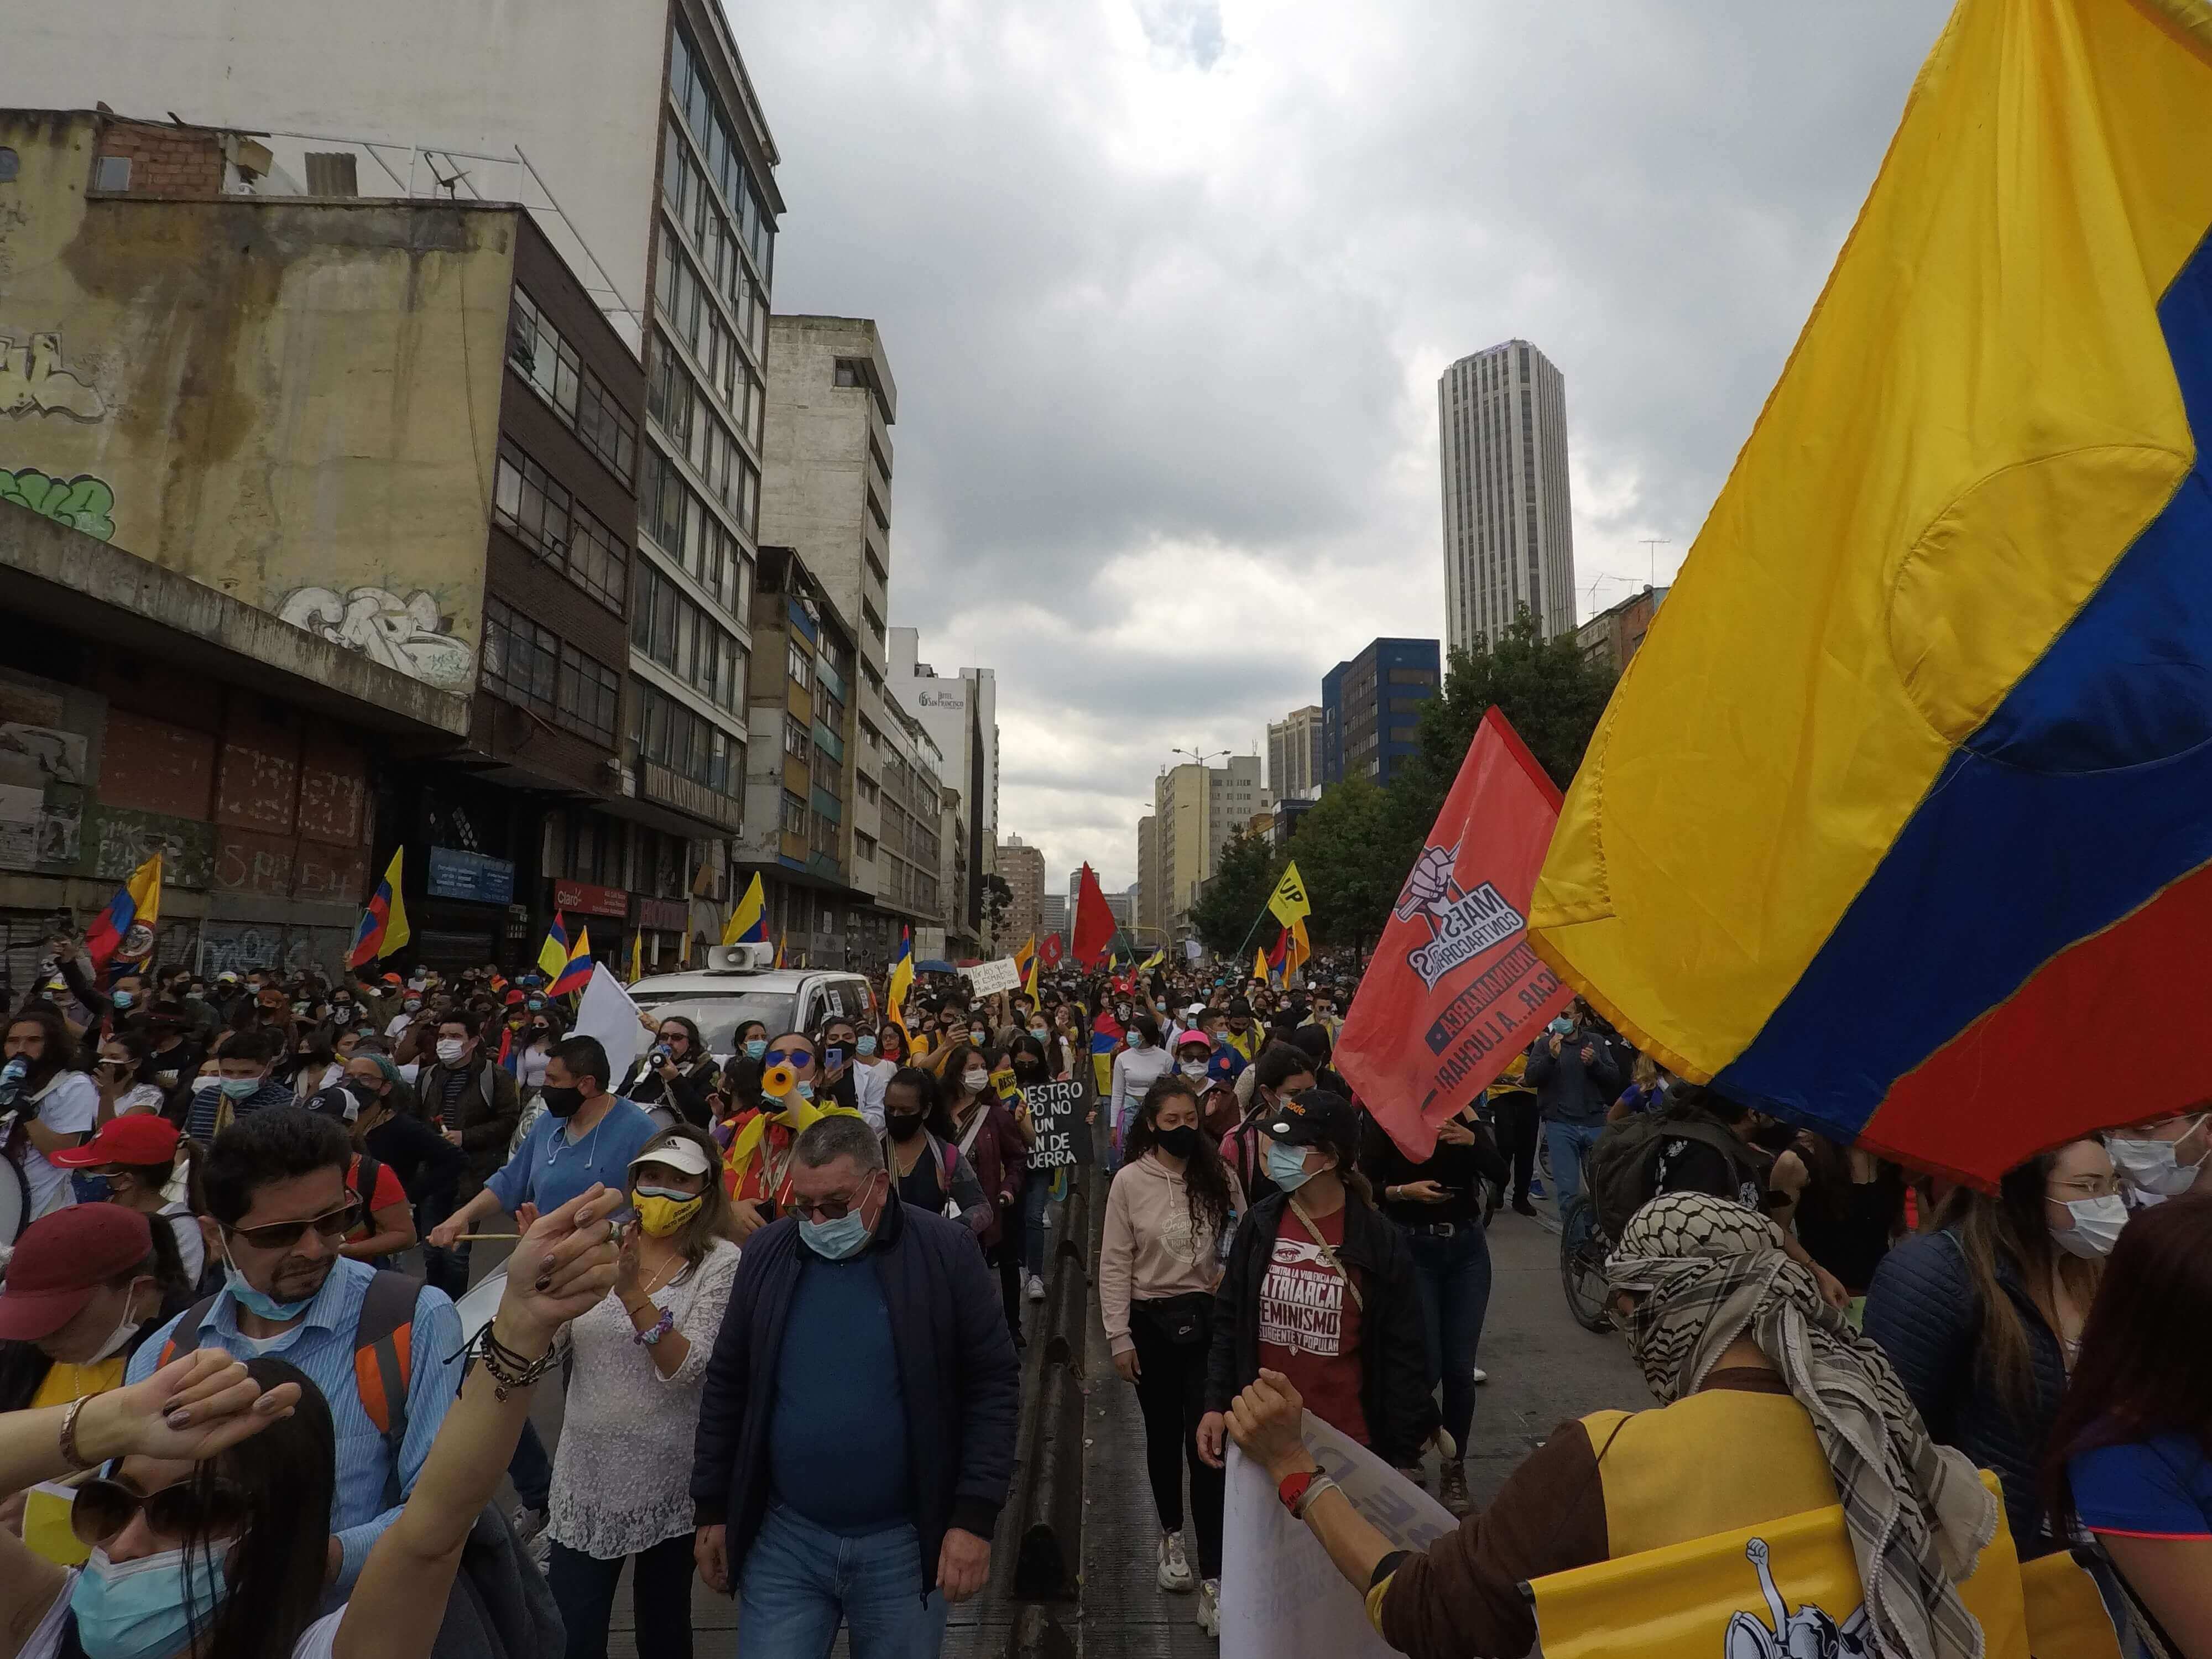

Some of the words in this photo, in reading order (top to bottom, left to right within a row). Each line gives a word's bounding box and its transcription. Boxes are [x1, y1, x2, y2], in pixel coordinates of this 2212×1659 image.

[928, 697, 937, 707] SAN
[938, 698, 964, 707] FRANCISCO
[557, 890, 579, 906] Claro
[1280, 877, 1304, 902] UP
[1051, 1100, 1071, 1115] NO
[1035, 1117, 1055, 1133] UN
[1050, 1132, 1070, 1151] DE
[1026, 1150, 1077, 1170] UERRA
[1269, 1264, 1291, 1276] CONTRA
[1291, 1268, 1298, 1279] LA
[1300, 1270, 1330, 1283] VIOLENCIA
[1260, 1274, 1344, 1310] ATRIARCAL
[1261, 1300, 1338, 1335] EMINISMO
[1295, 1332, 1302, 1345] Y
[1303, 1335, 1339, 1352] POPULAR
